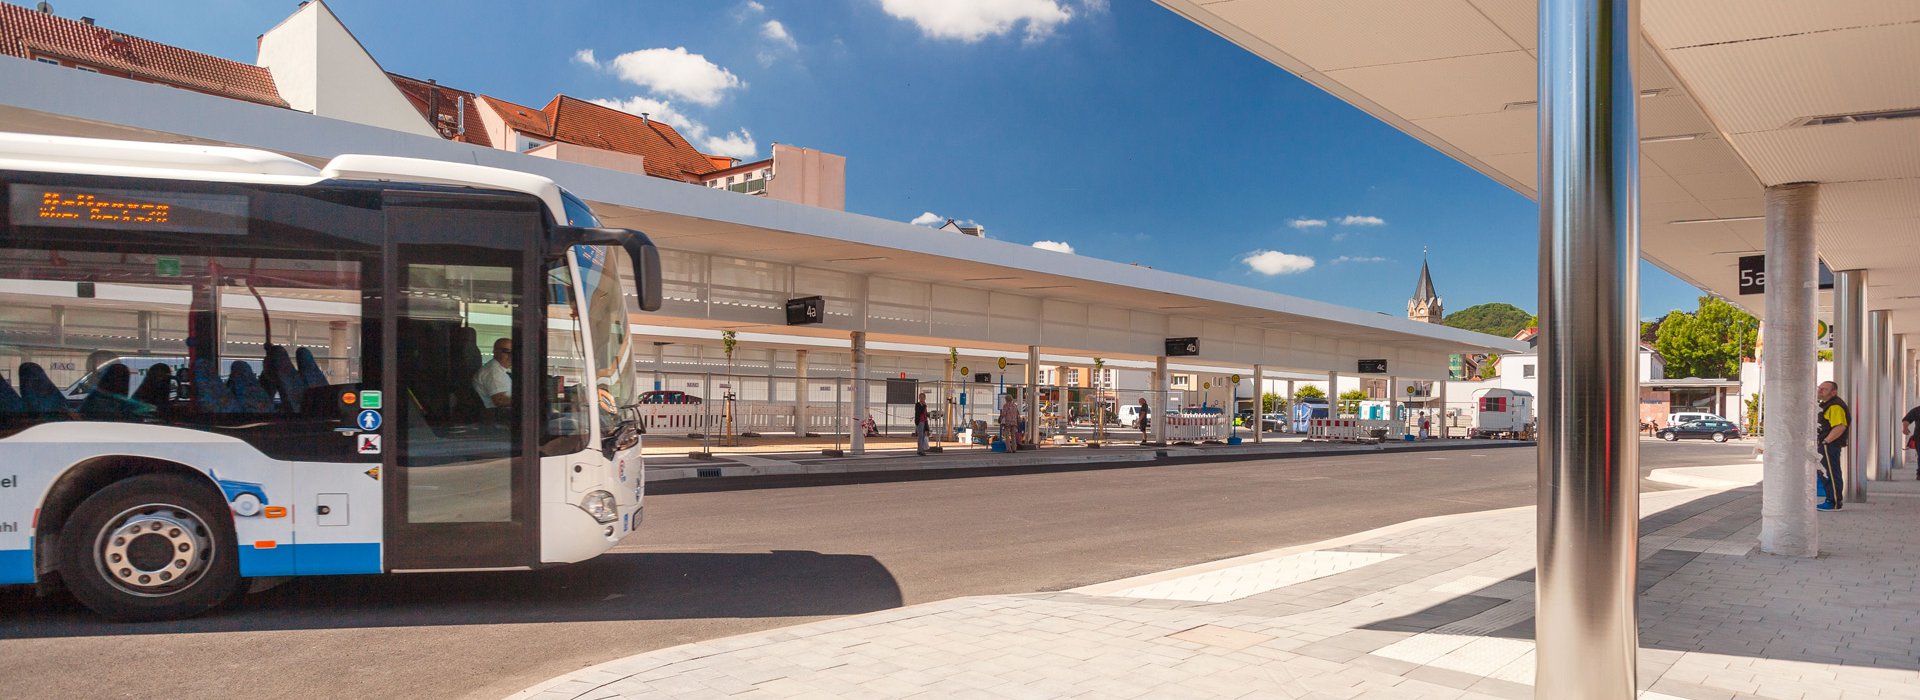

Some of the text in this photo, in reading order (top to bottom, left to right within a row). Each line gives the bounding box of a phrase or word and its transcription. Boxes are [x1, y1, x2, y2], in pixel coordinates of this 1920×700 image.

[1741, 270, 1765, 286] 5a
[807, 305, 816, 317] 4a
[0, 521, 18, 533] hl
